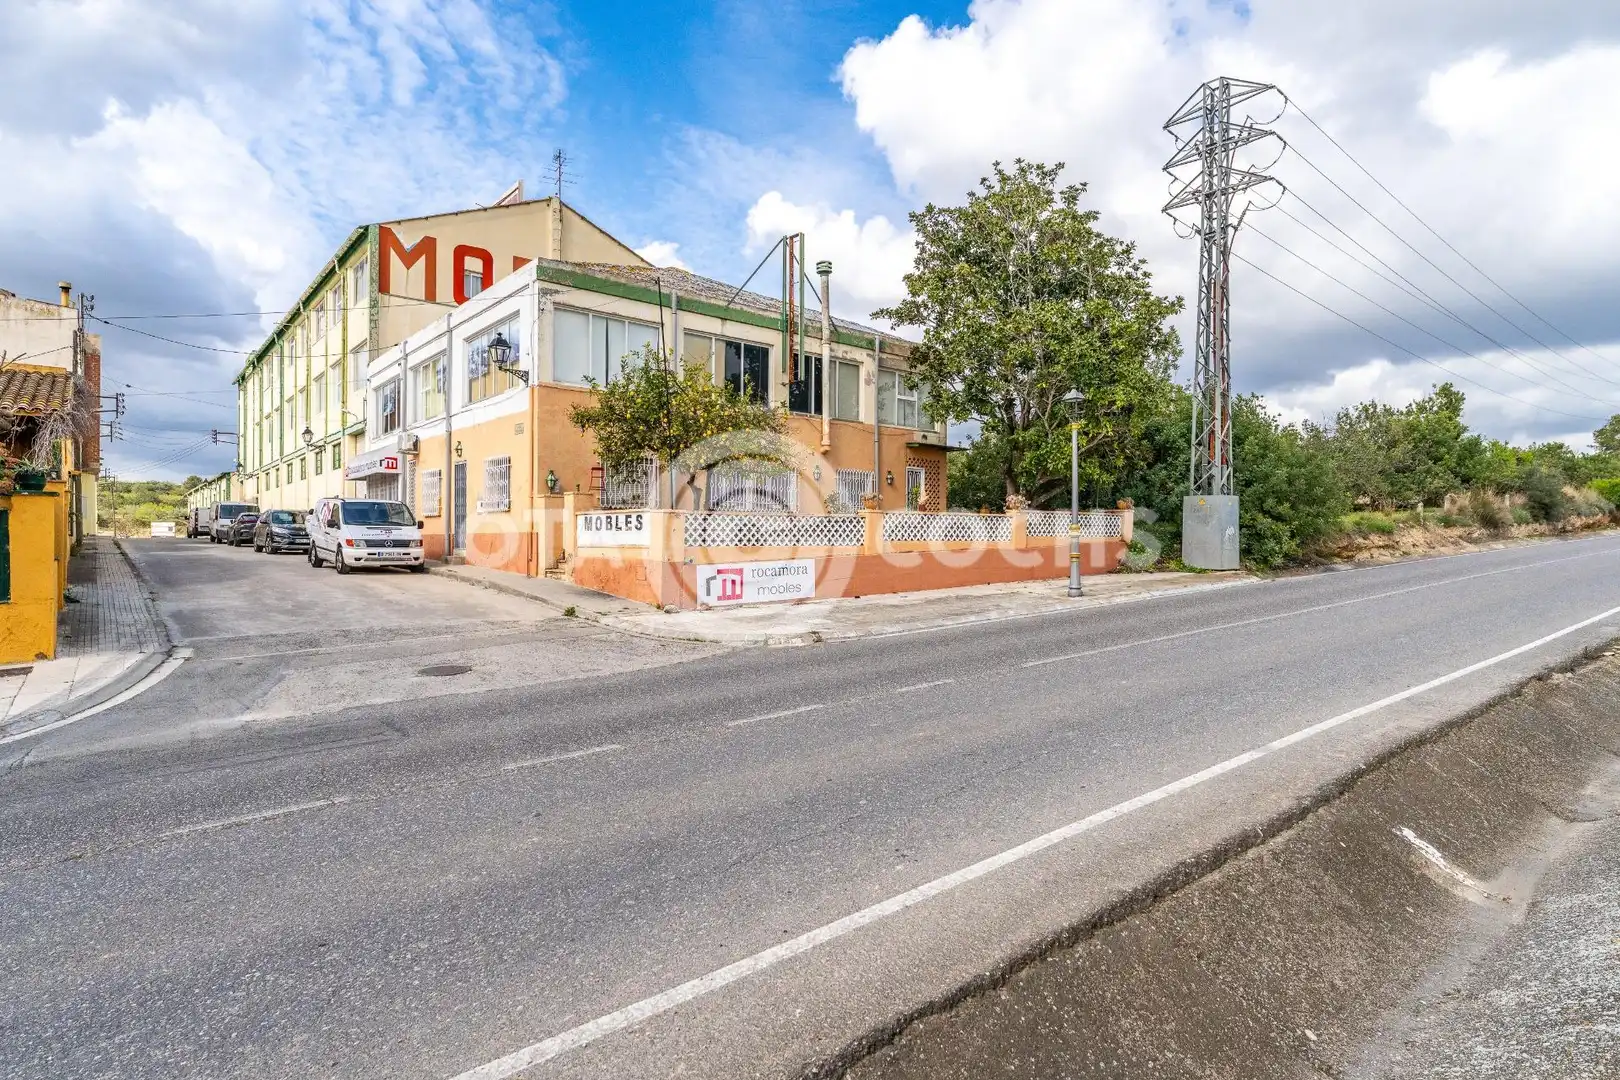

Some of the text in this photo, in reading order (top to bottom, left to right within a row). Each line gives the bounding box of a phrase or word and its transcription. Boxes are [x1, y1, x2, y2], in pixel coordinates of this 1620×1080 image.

[379, 224, 533, 306] MO
[584, 514, 644, 532] MOBLES
[751, 563, 809, 579] rocamora
[757, 582, 802, 596] mobles
